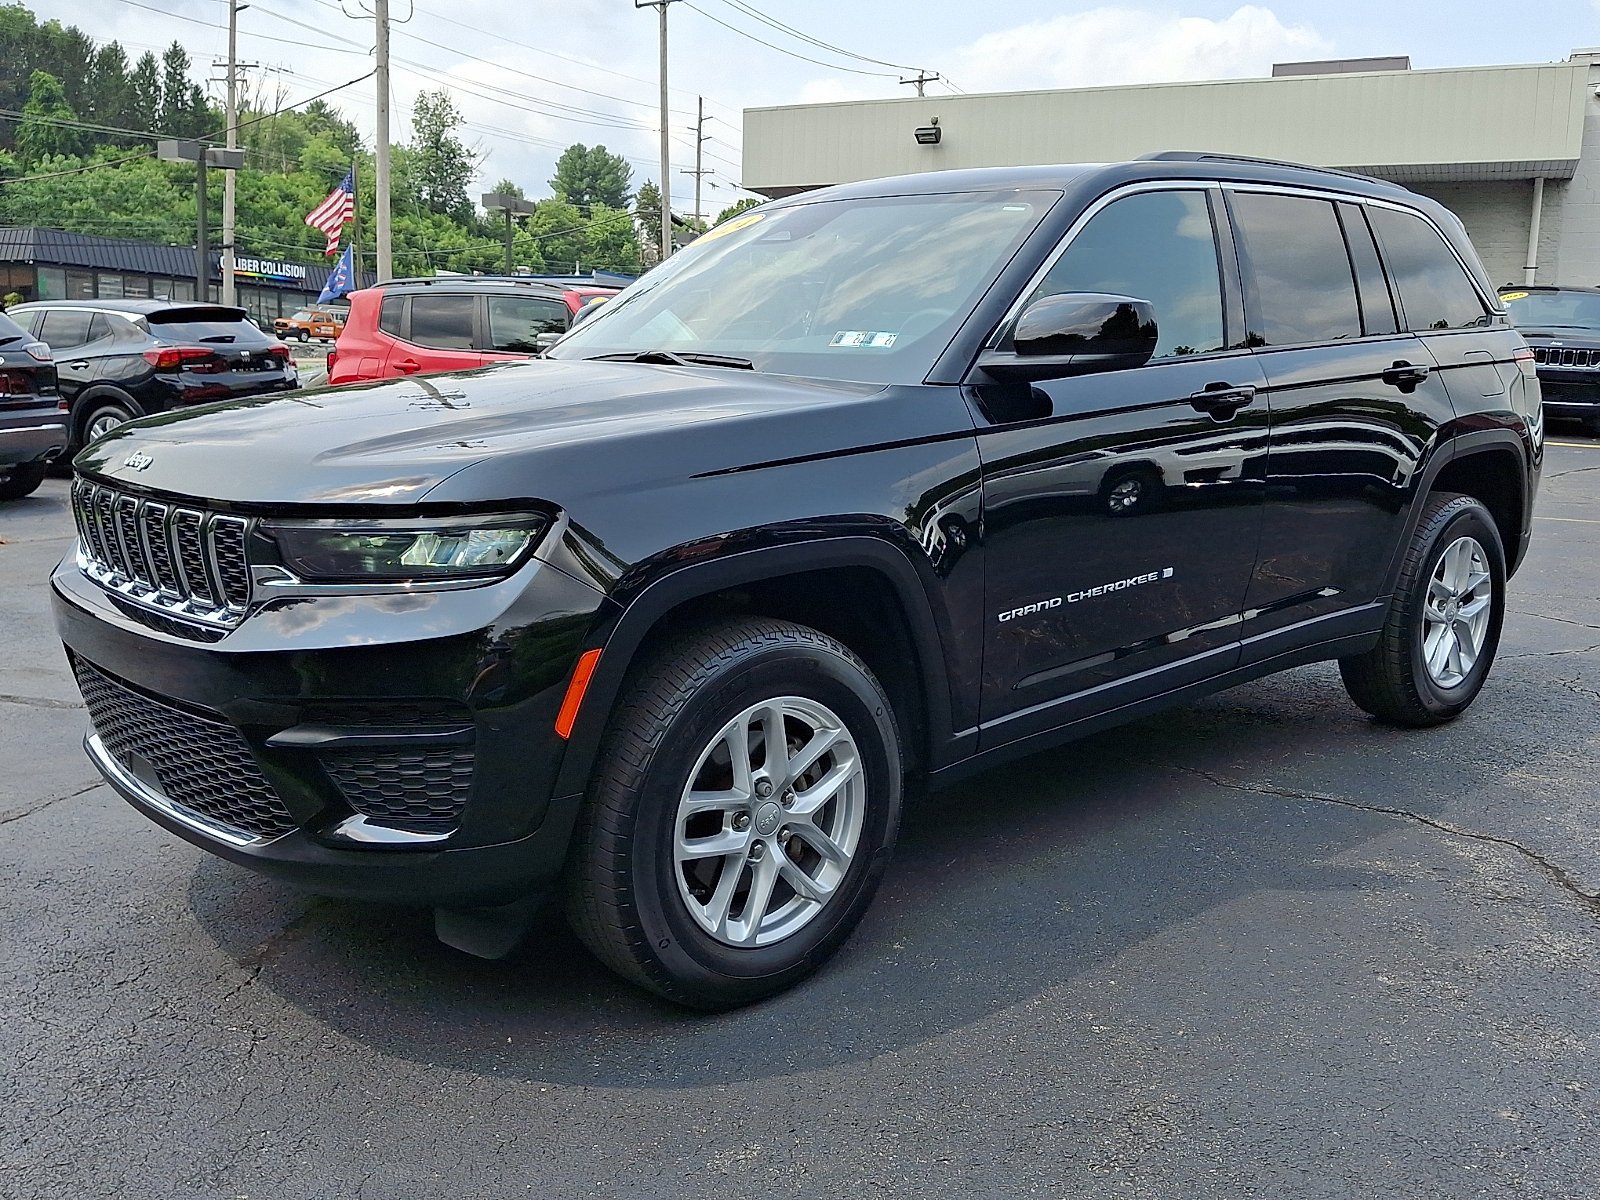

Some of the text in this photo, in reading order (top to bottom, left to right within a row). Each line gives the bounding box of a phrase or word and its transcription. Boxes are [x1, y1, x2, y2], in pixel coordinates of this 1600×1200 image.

[220, 256, 305, 278] CLIBER COLLISION
[124, 450, 153, 472] Jeep
[998, 571, 1158, 622] GRAND CHEROKEE
